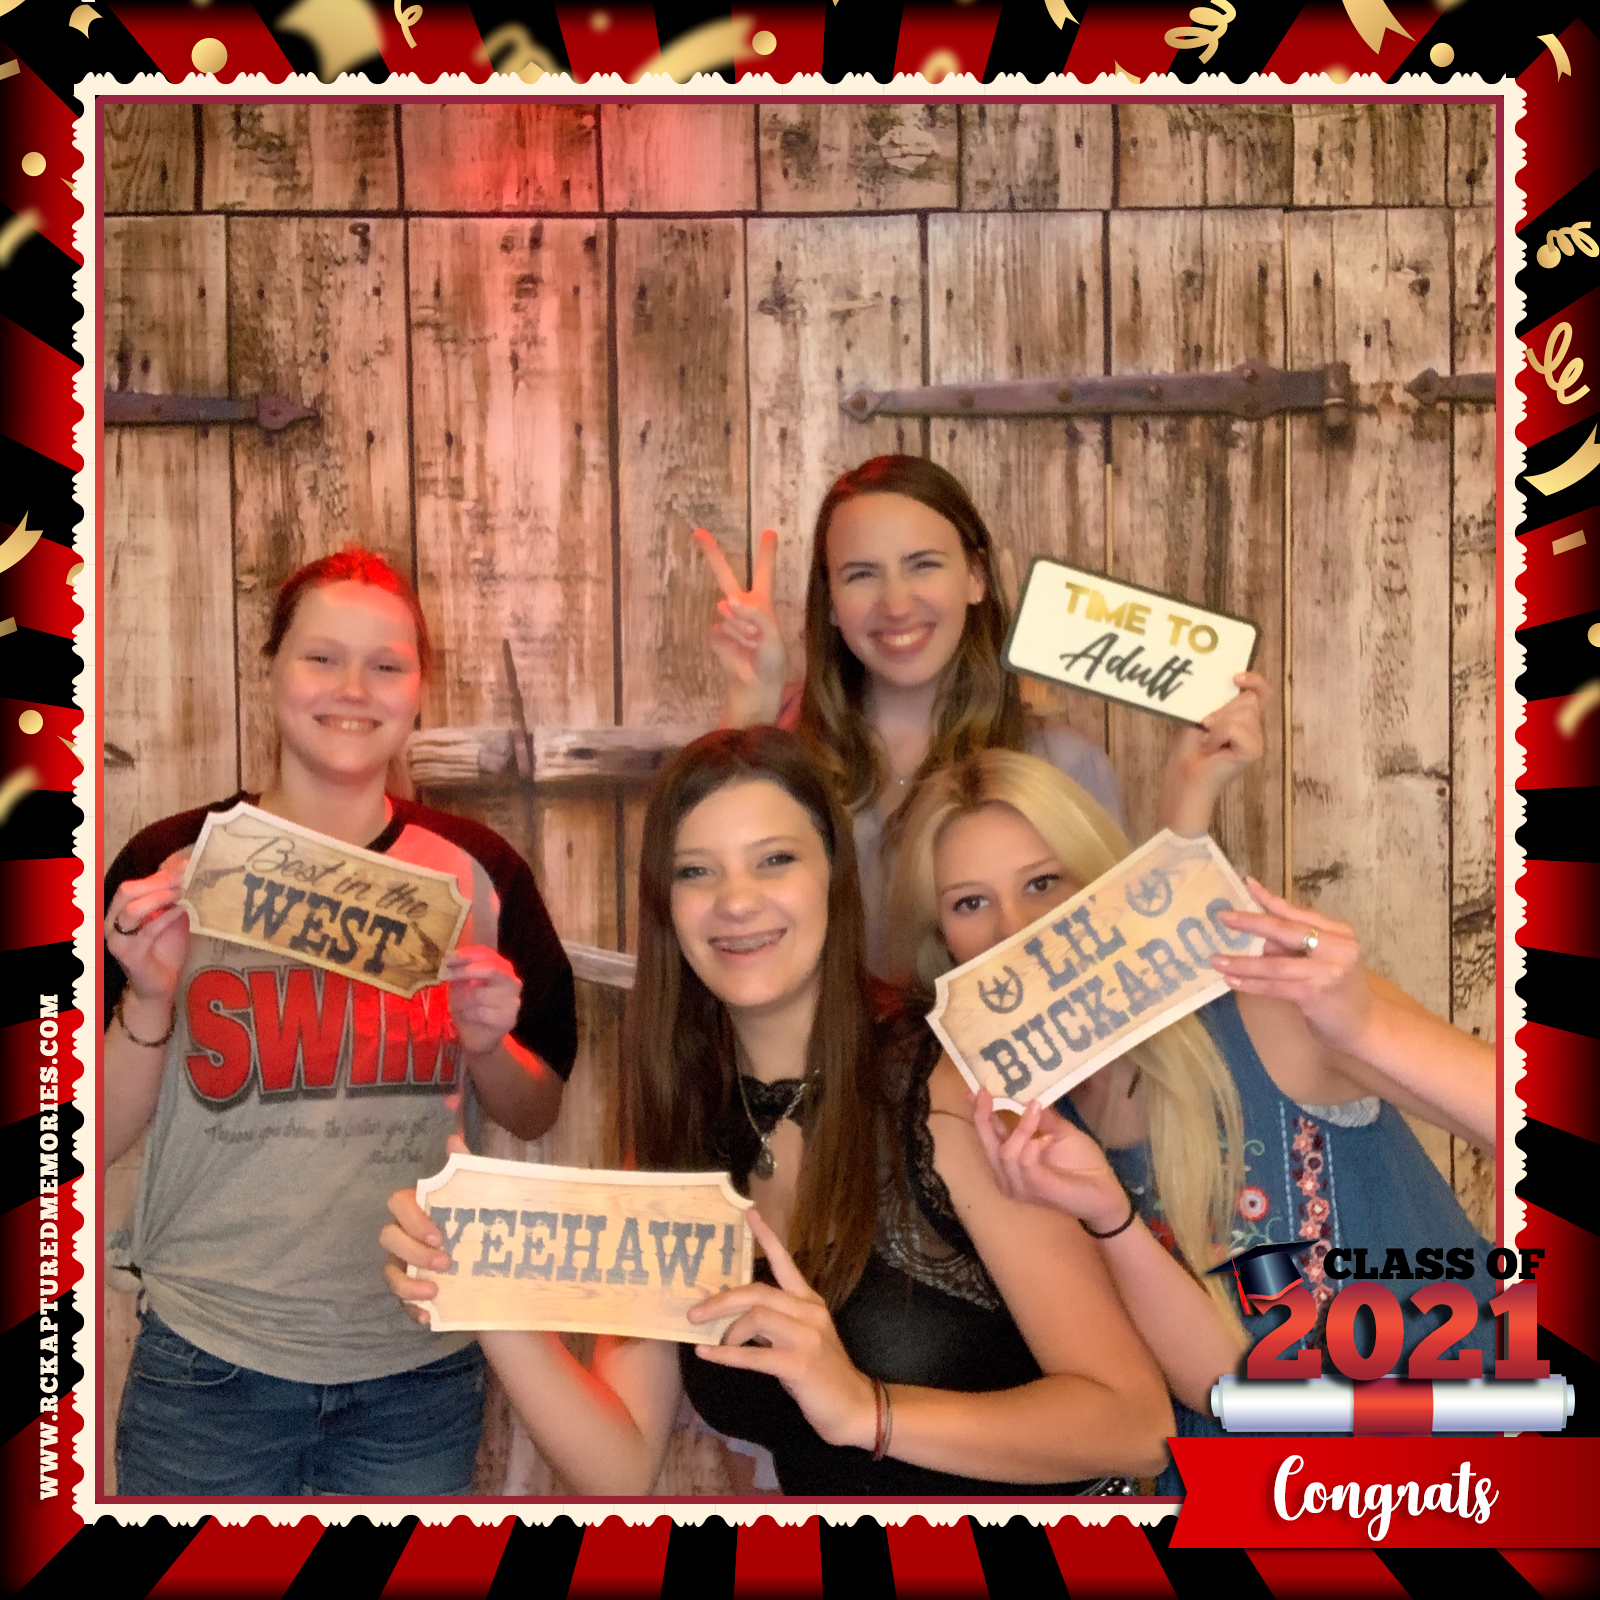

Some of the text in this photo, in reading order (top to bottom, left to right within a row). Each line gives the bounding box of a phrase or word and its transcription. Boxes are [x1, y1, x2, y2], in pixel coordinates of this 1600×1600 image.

[1065, 581, 1219, 654] TIME TO
[1059, 632, 1193, 702] Adult
[224, 824, 428, 918] Best in the
[241, 873, 408, 975] WEST
[185, 966, 460, 1101] SWIM
[430, 1207, 736, 1292] YEEHAW!
